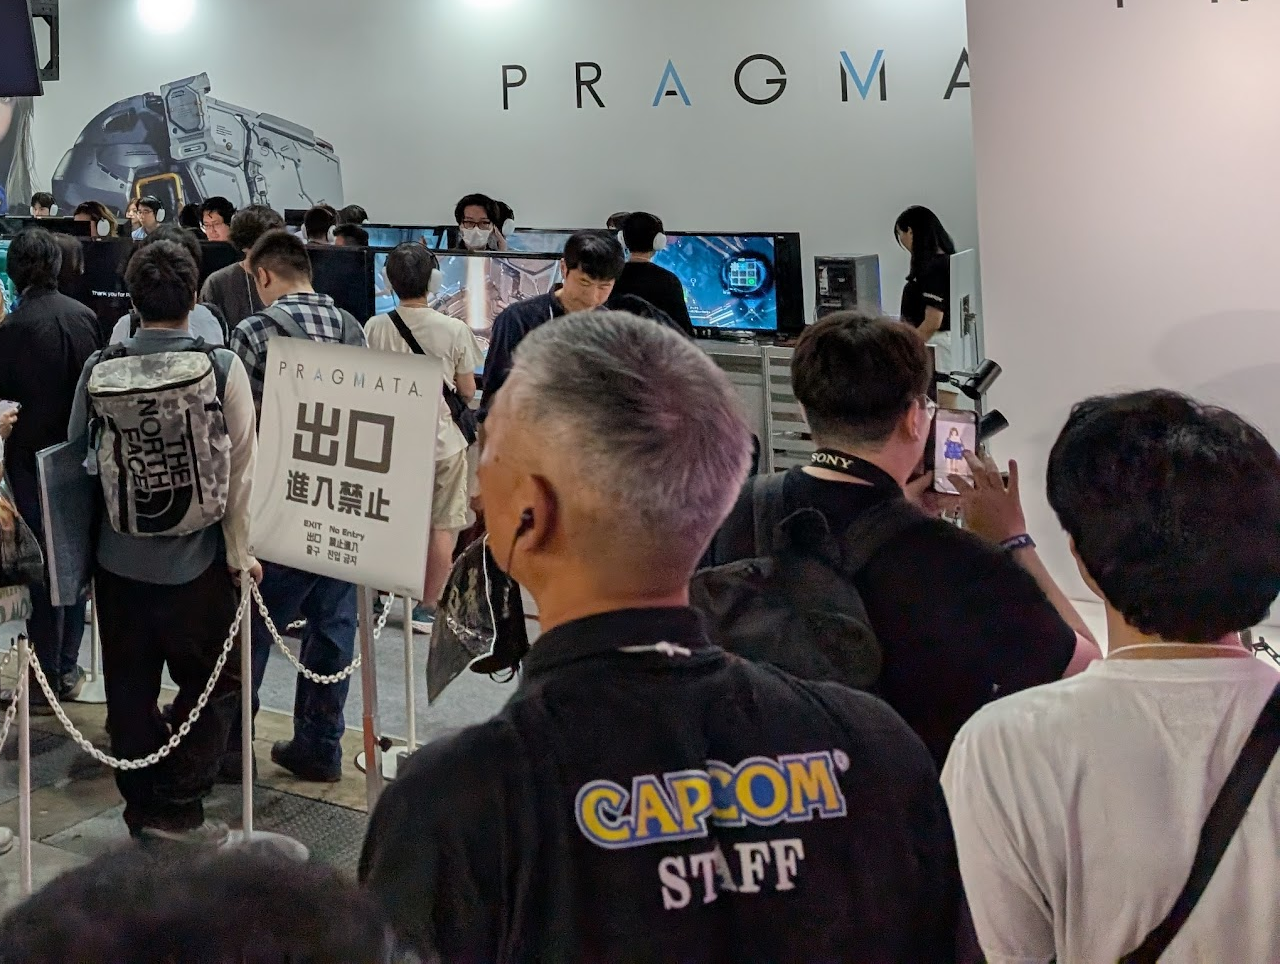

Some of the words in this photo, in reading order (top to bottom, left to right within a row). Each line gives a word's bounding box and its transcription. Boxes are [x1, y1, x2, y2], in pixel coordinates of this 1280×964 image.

[279, 361, 420, 397] PRAGMATA
[121, 427, 151, 490] FACE
[137, 398, 171, 487] NORTH
[165, 434, 191, 486] THE
[292, 402, 395, 474] 出口
[811, 452, 854, 469] SONY
[286, 470, 391, 522] 進入禁止
[303, 519, 322, 530] EXIT
[329, 525, 340, 534] No
[342, 528, 365, 541] Entry
[306, 531, 322, 543] 出口
[575, 751, 847, 849] CAPCOM
[657, 838, 806, 911] STAFF
